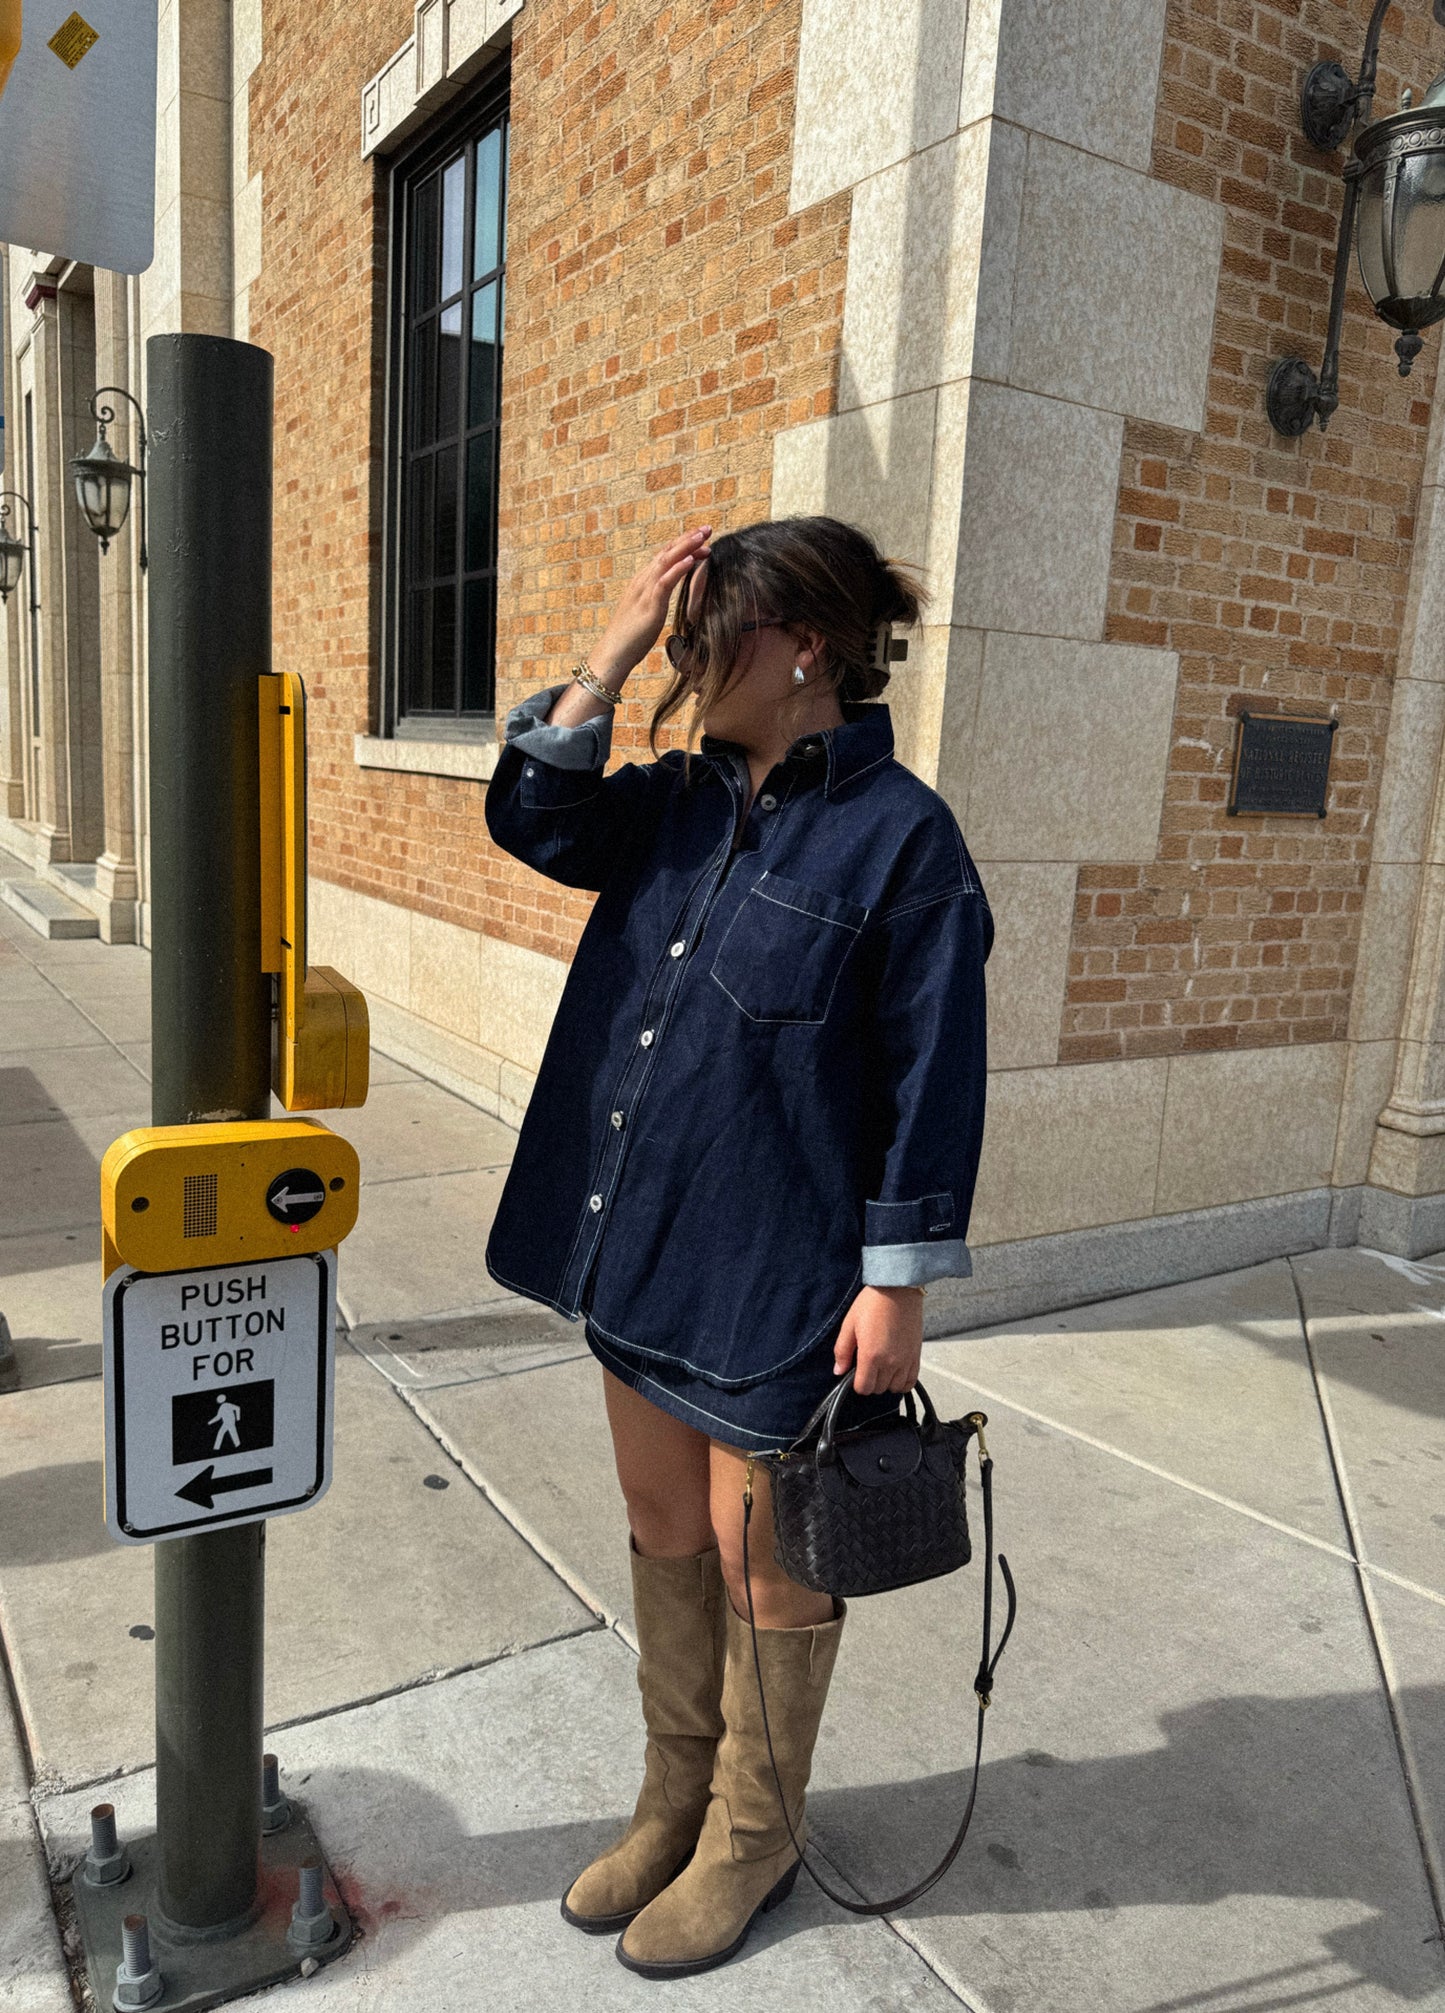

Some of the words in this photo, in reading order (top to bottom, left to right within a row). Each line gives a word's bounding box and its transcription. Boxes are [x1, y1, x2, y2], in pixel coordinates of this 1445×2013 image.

[181, 1274, 267, 1312] PUSH
[161, 1307, 285, 1351] BUTTON
[193, 1348, 255, 1381] FOR
